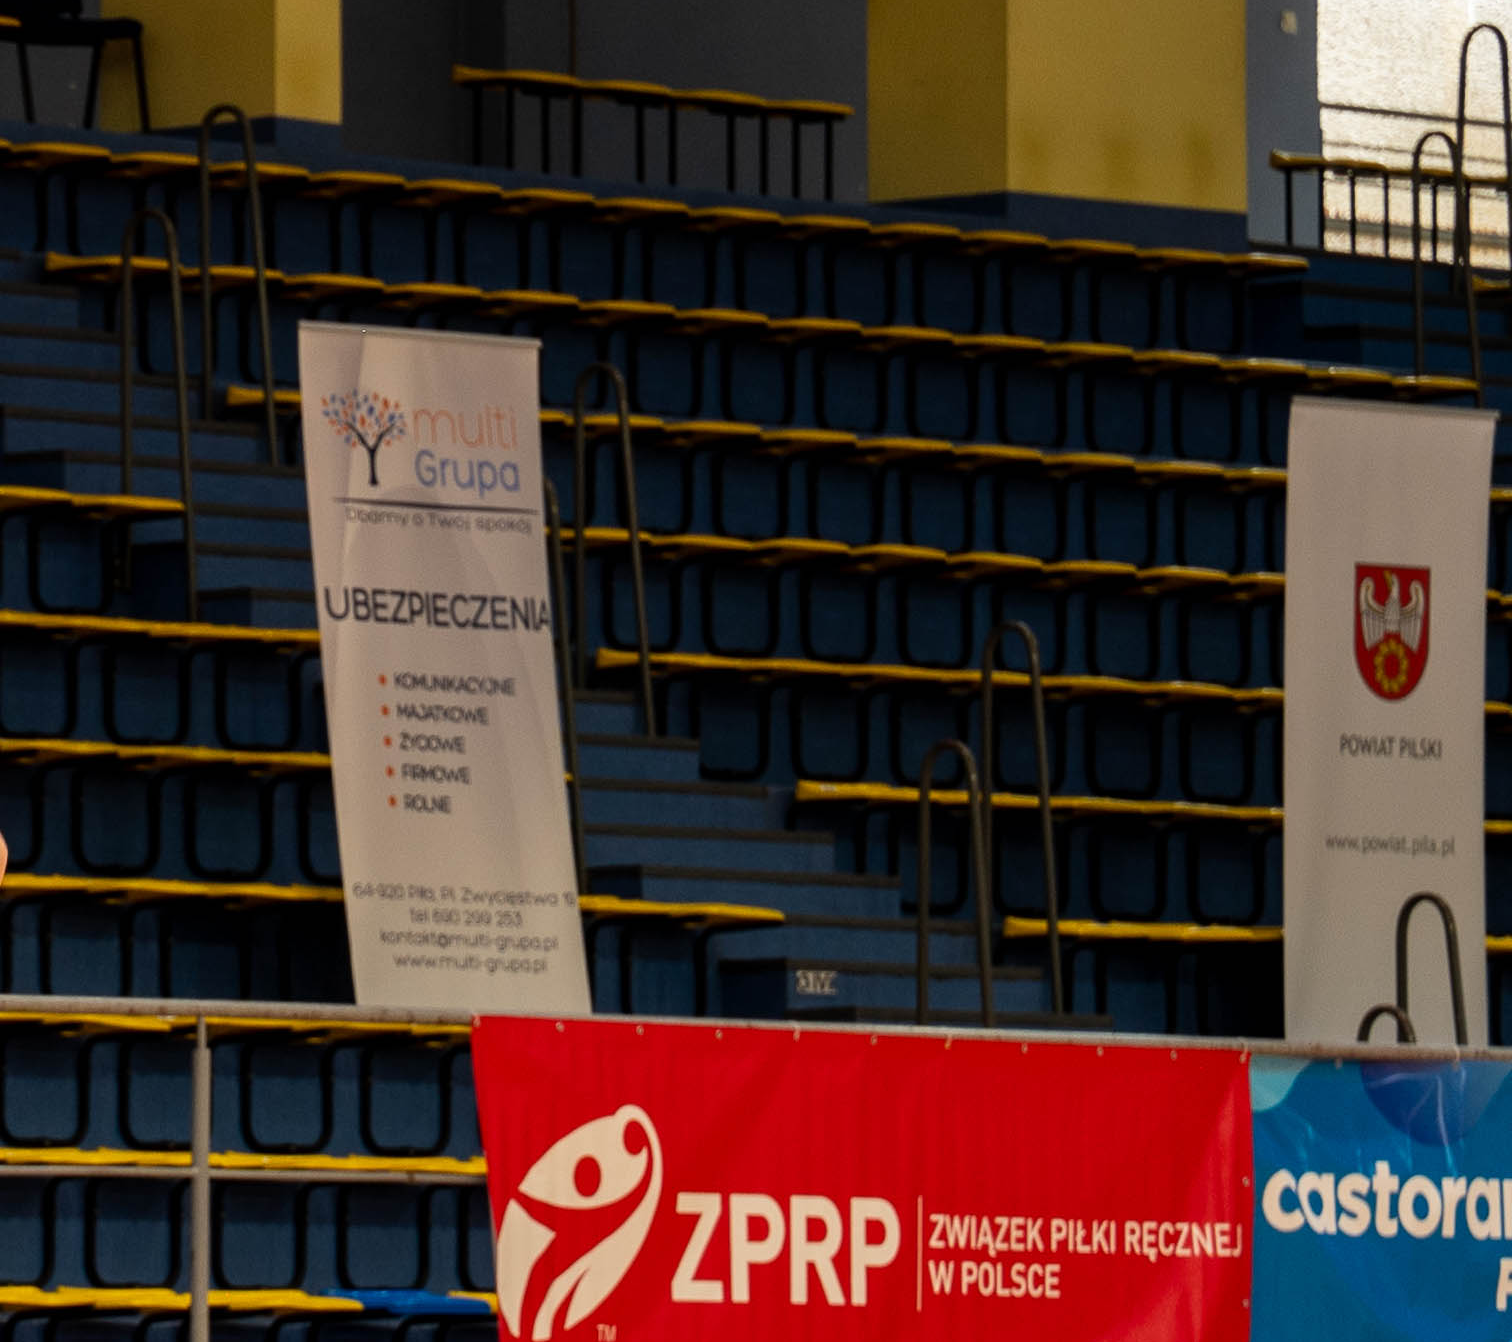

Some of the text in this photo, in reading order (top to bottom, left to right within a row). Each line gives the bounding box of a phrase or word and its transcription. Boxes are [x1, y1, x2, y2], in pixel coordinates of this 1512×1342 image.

[413, 407, 519, 451] multi
[415, 449, 521, 498] Grupa
[323, 585, 551, 632] UBEZPIECZENIA
[1339, 733, 1395, 758] POWIAT
[1261, 1159, 1512, 1241] castora
[670, 1190, 902, 1307] ZPRP
[928, 1213, 1243, 1263] ZWIĄZEK PIŁKI RĘCZNEJ
[927, 1259, 1062, 1299] W POLSCE
